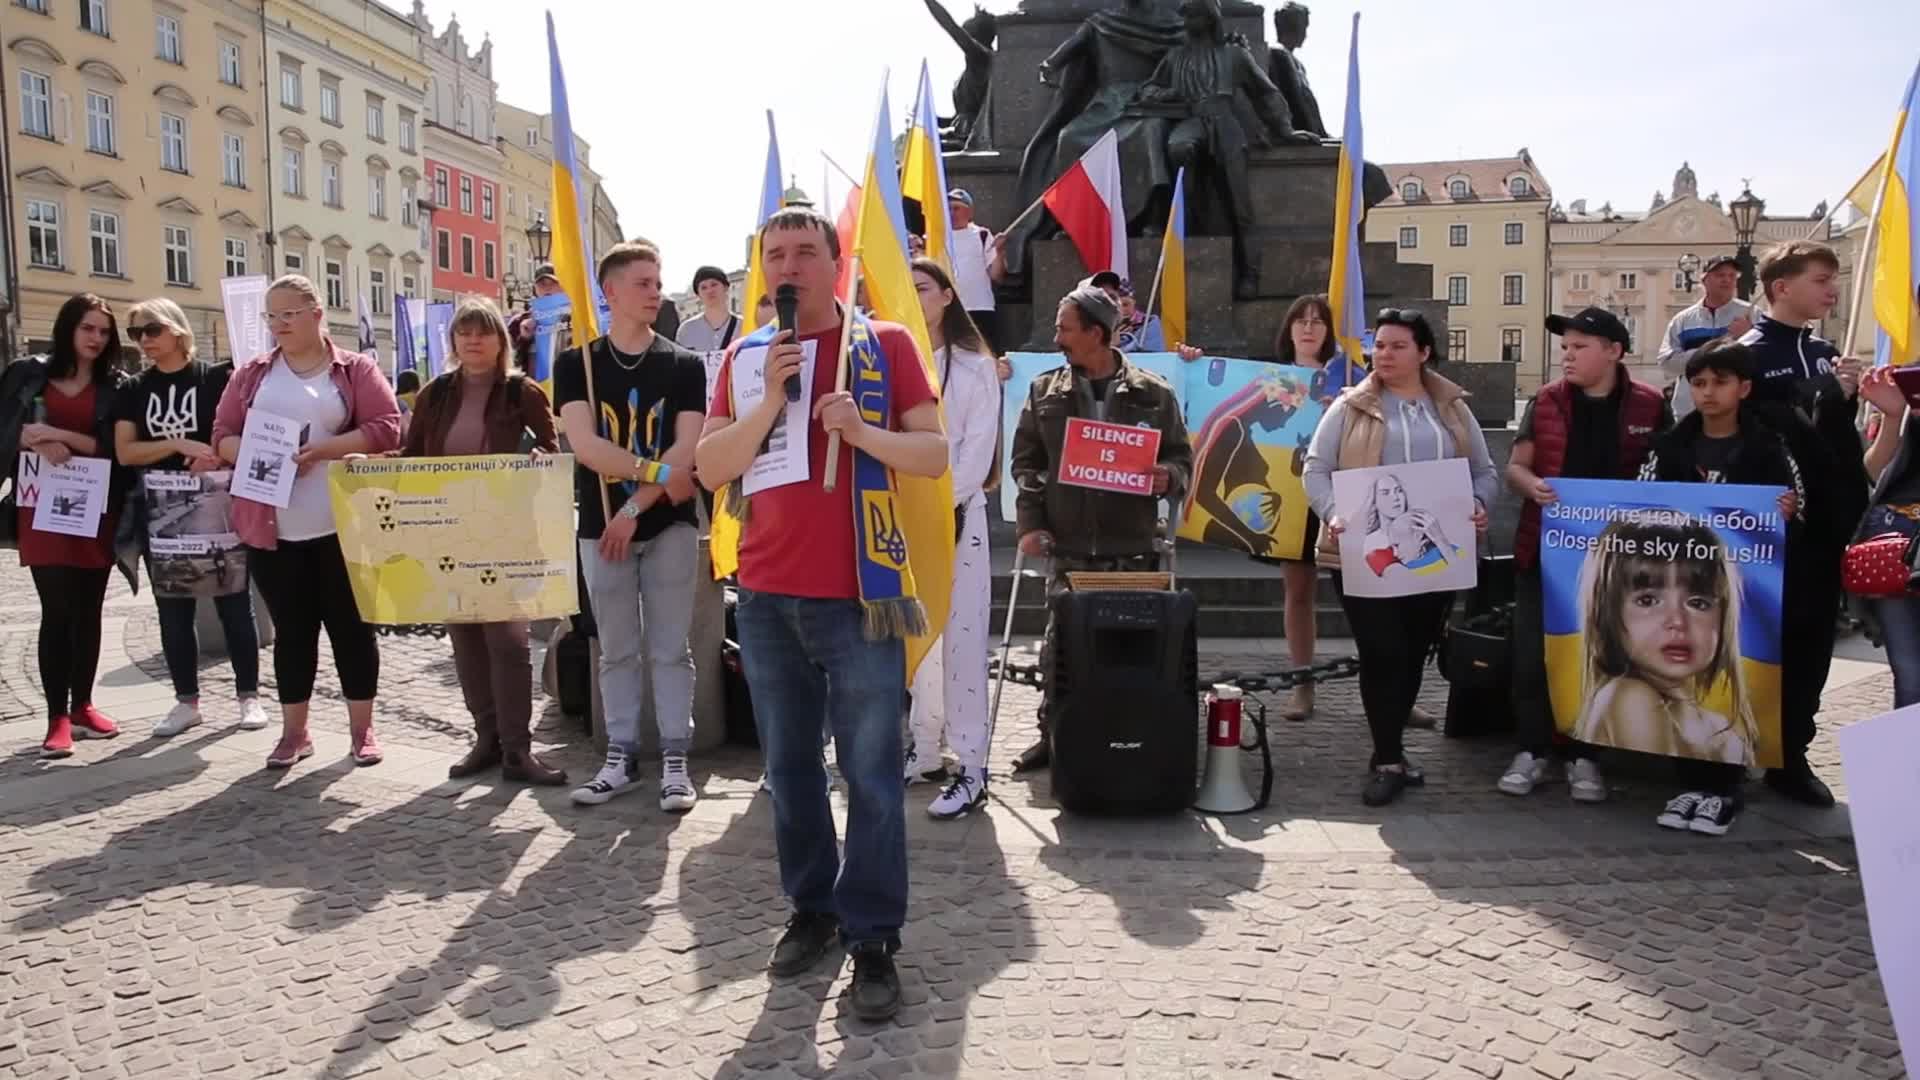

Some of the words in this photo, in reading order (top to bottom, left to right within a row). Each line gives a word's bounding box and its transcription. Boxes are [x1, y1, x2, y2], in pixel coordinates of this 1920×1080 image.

[264, 422, 286, 434] NATO
[1081, 426, 1145, 447] SILENCE
[1100, 449, 1115, 463] IS
[64, 463, 89, 474] NATO
[346, 463, 392, 474] Атомні
[395, 461, 496, 474] електростанції
[500, 459, 553, 472] України
[1068, 464, 1147, 487] VIOLENCE
[176, 478, 196, 488] 1941
[1547, 502, 1641, 524] Закрийте
[1647, 510, 1691, 527] нам
[1699, 509, 1777, 532] небо!!!
[180, 543, 203, 551] 2022
[1545, 529, 1600, 551] Close
[1605, 533, 1637, 554] the
[1643, 536, 1680, 562] sky
[1686, 538, 1718, 561] for
[1724, 544, 1774, 565] us!!!
